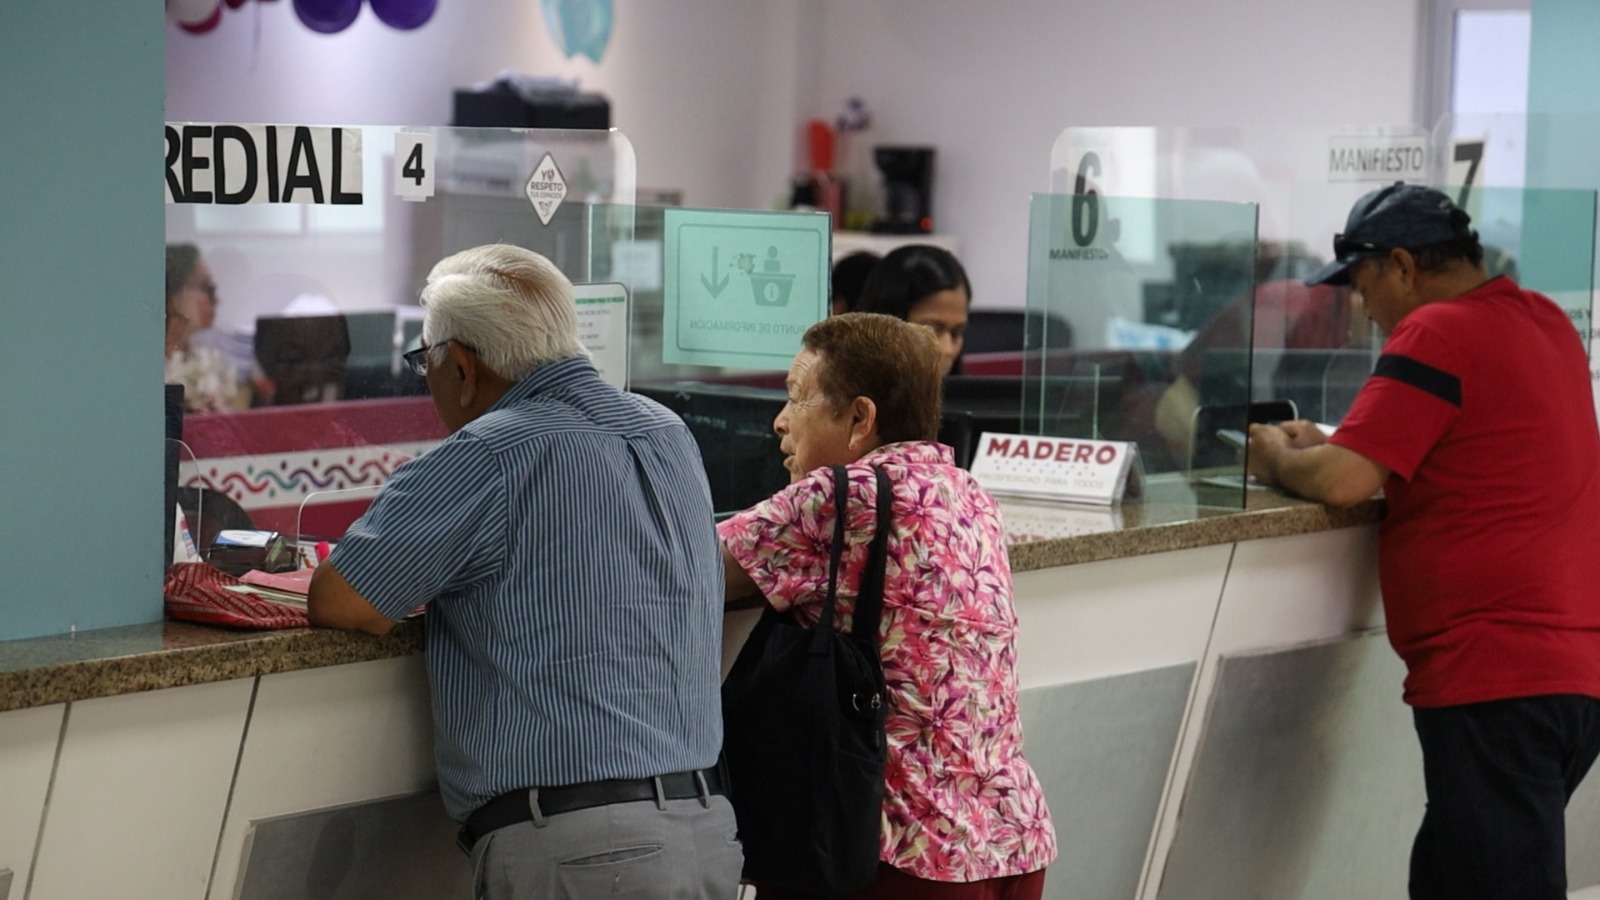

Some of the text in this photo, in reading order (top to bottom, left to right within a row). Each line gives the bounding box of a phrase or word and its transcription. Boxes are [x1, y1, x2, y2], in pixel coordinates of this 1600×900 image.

[402, 143, 425, 186] 4
[1329, 146, 1424, 172] MANIFIESTO
[530, 181, 564, 192] RESPETO
[1453, 140, 1485, 210] 7
[1071, 151, 1102, 248] 6
[986, 437, 1117, 465] MADERO
[1044, 475, 1068, 486] PARA
[1073, 478, 1105, 489] TODOS
